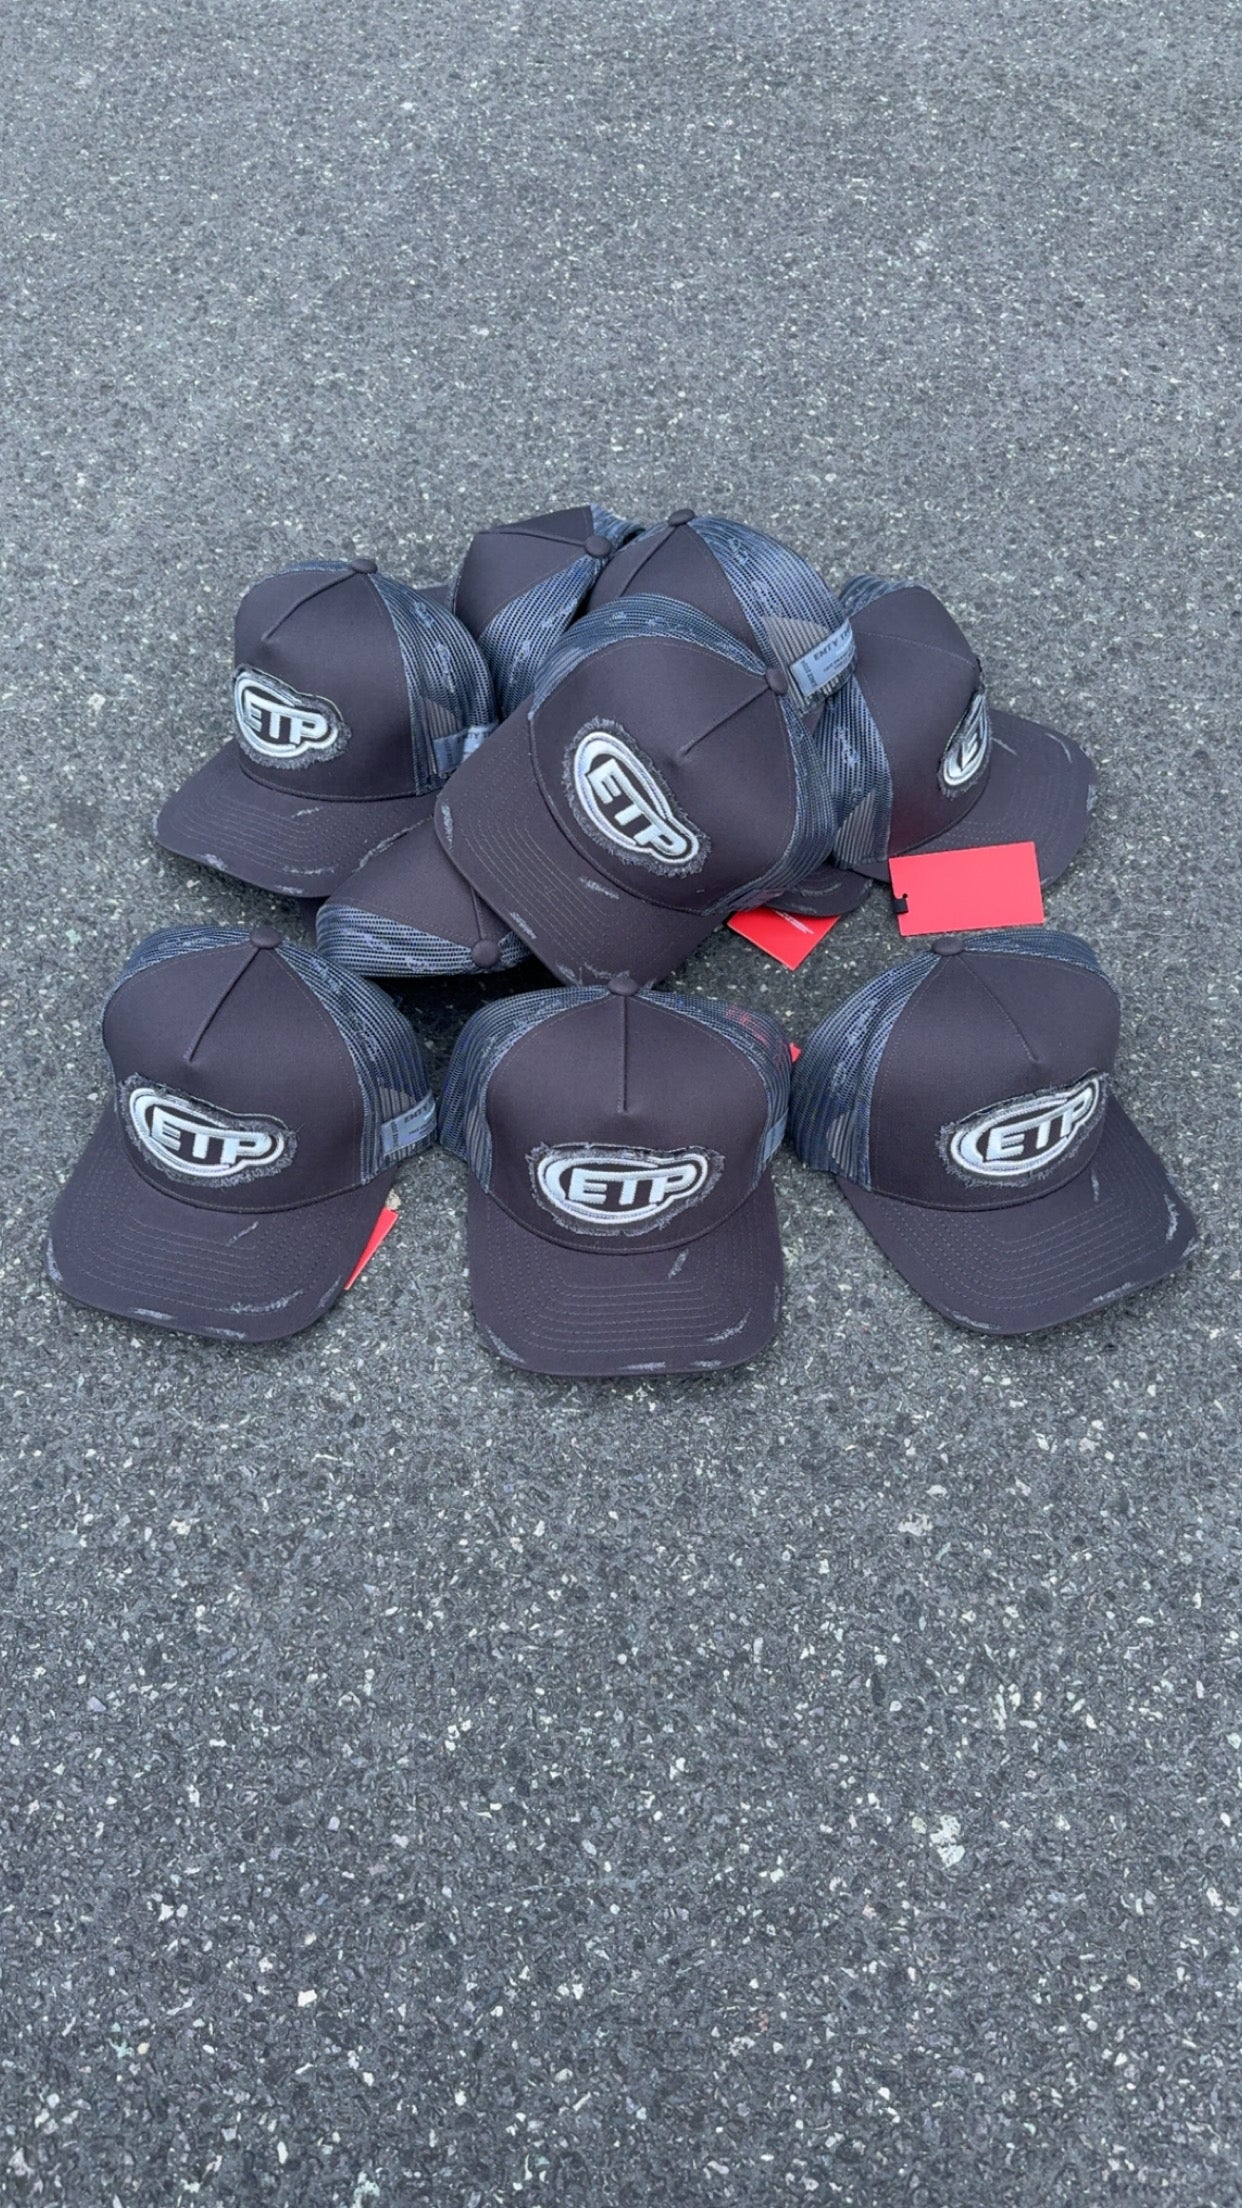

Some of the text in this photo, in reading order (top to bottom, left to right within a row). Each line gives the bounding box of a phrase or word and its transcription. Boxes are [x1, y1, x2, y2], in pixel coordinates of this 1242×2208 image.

[243, 688, 328, 745] ETP
[587, 758, 687, 856] ETP
[152, 1106, 273, 1165] ETP
[986, 1087, 1094, 1161] ETP
[568, 1163, 697, 1206] ETP
